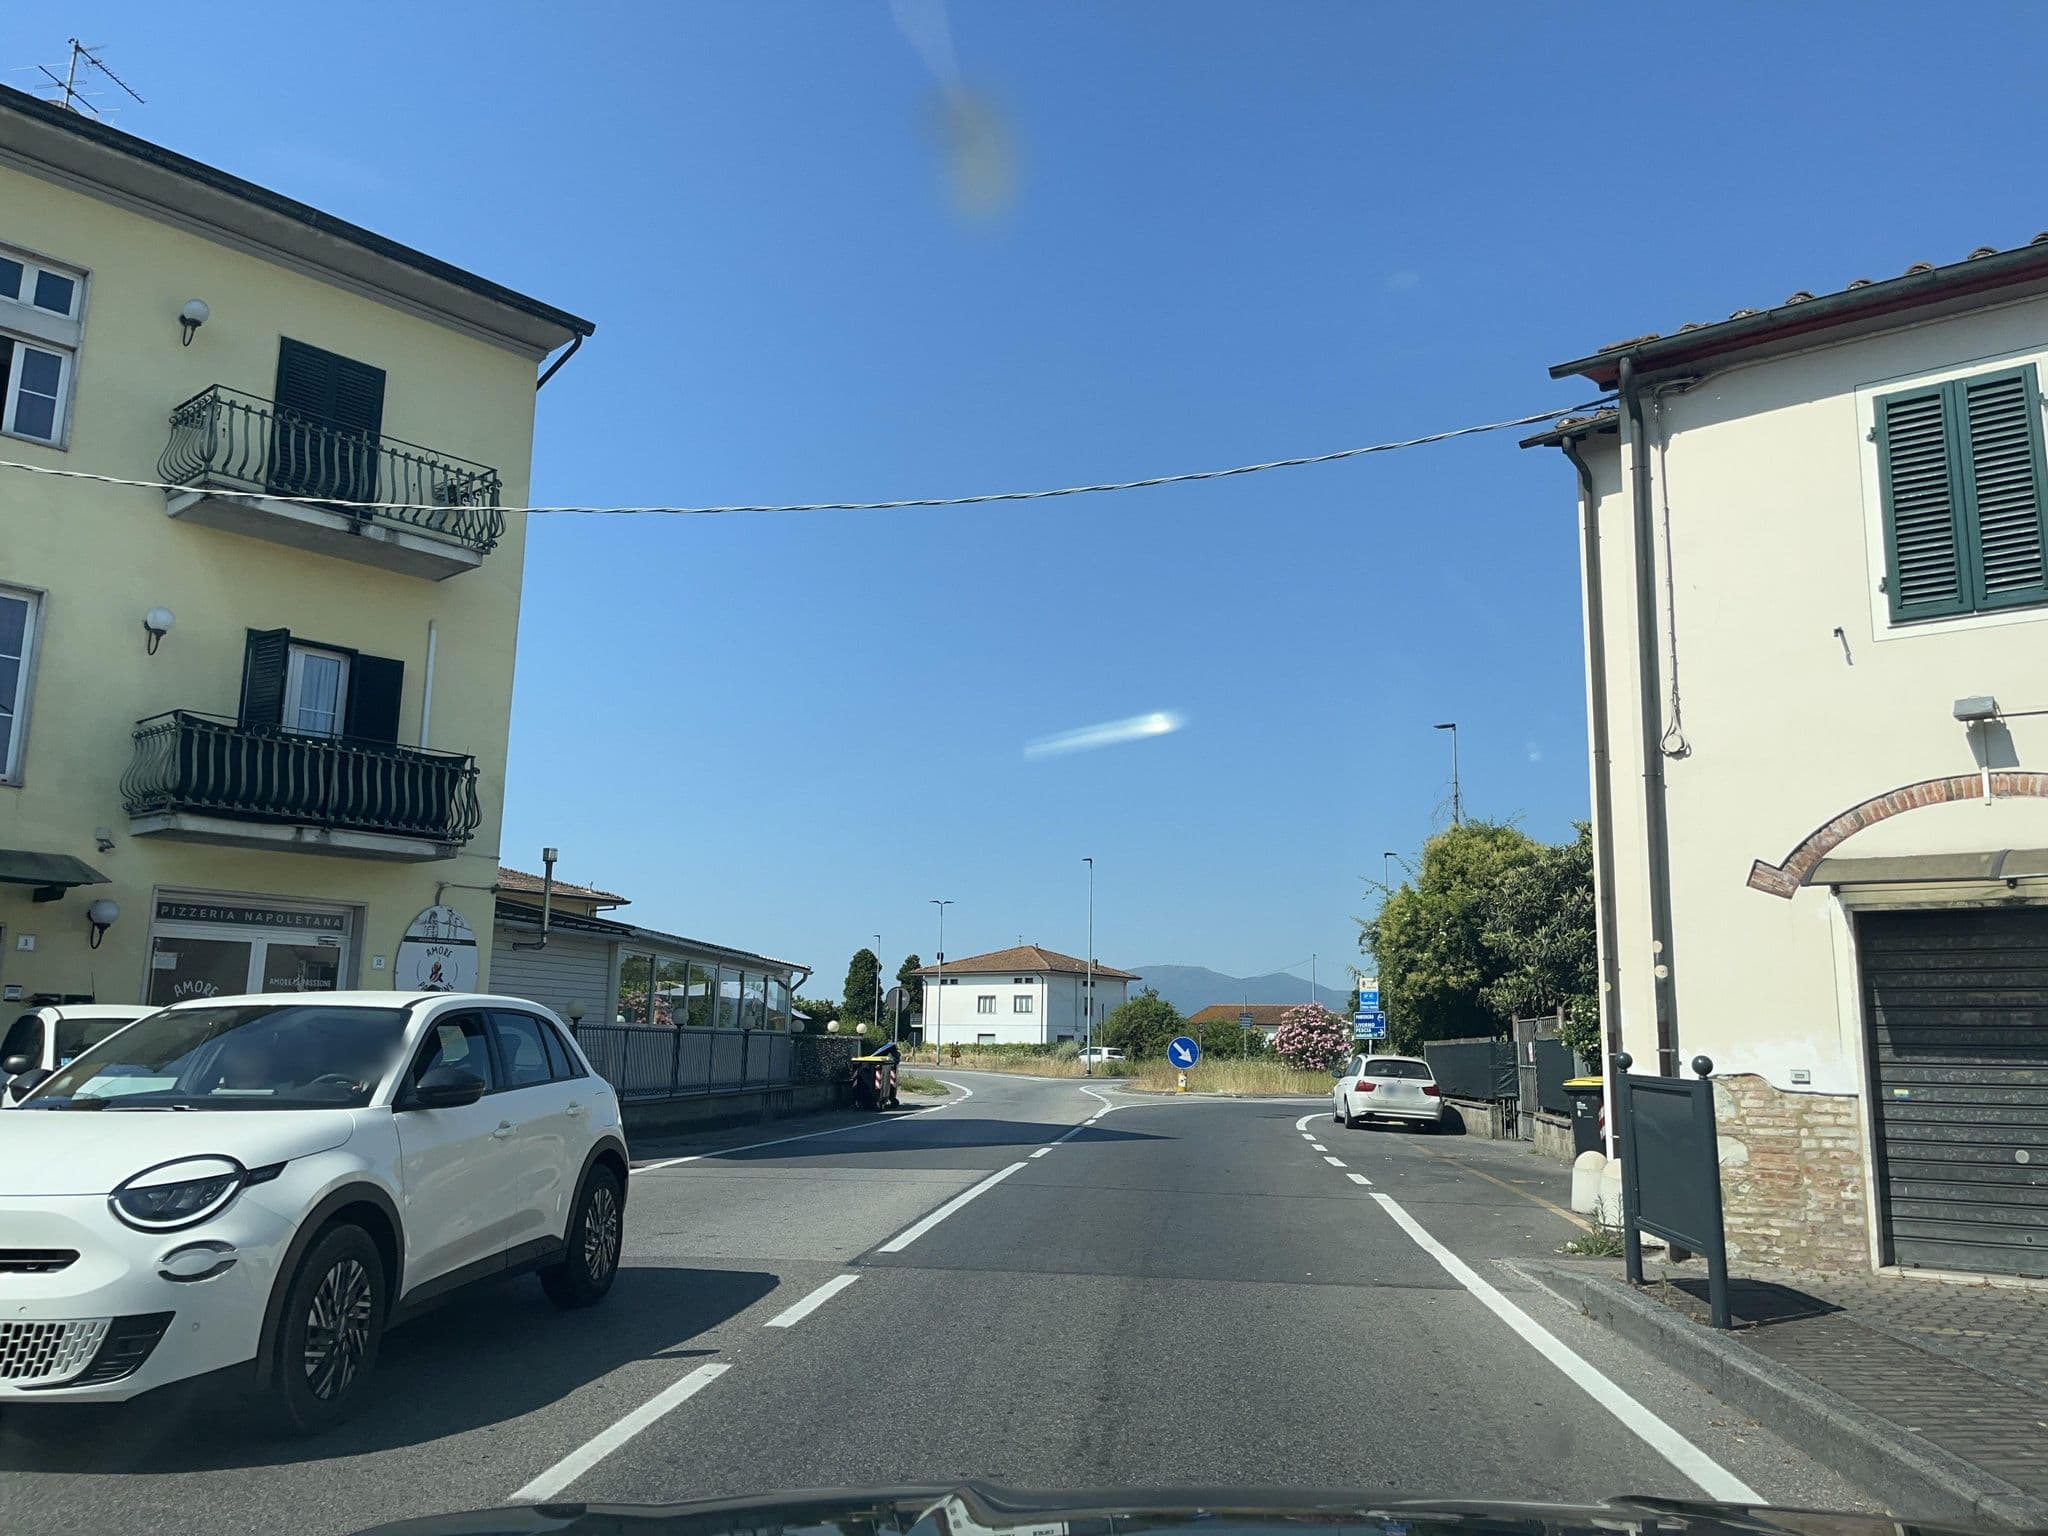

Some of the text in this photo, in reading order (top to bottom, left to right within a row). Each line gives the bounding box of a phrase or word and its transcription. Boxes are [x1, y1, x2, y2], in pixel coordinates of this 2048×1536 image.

[160, 905, 342, 928] PIZZERIA NAPOLETANA
[426, 945, 454, 958] AMORE
[173, 979, 219, 998] AMORE
[269, 977, 293, 986] AMORE
